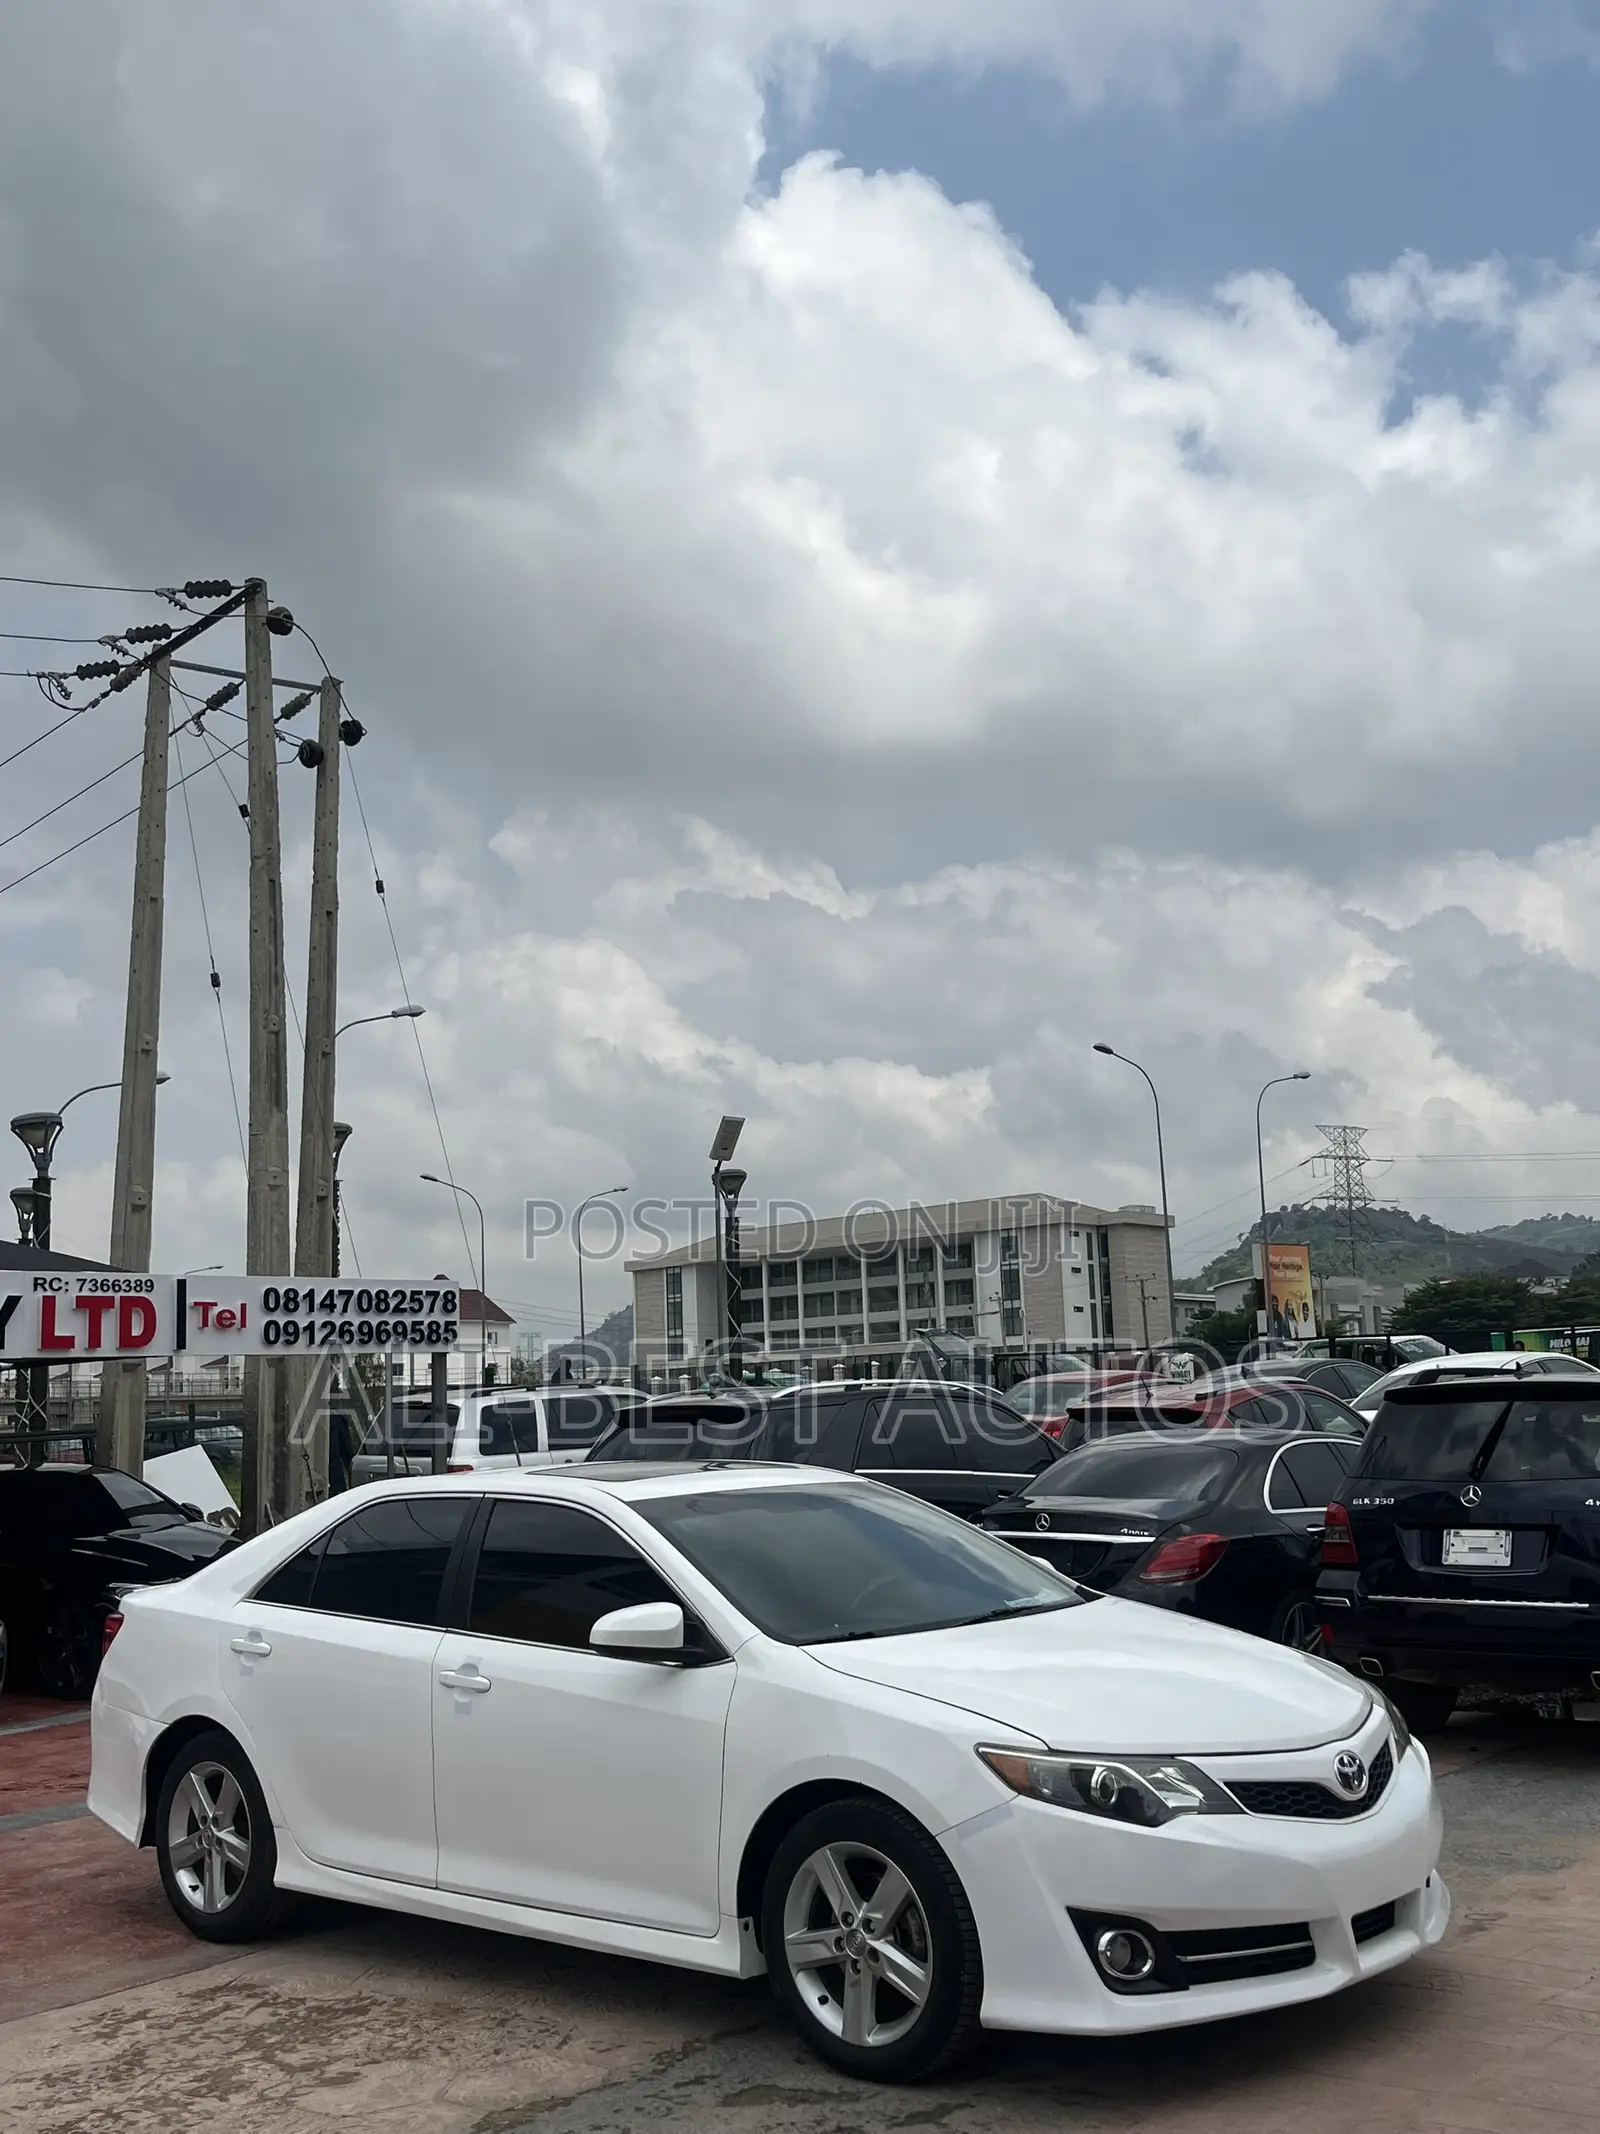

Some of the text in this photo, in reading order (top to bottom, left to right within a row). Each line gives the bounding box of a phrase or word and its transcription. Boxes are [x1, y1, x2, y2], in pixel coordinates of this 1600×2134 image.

[33, 1277, 155, 1293] RC: 7366389
[263, 1287, 457, 1314] 08147082578
[39, 1295, 157, 1350] LTD
[193, 1301, 247, 1330] Tel
[263, 1320, 458, 1347] 09126969585
